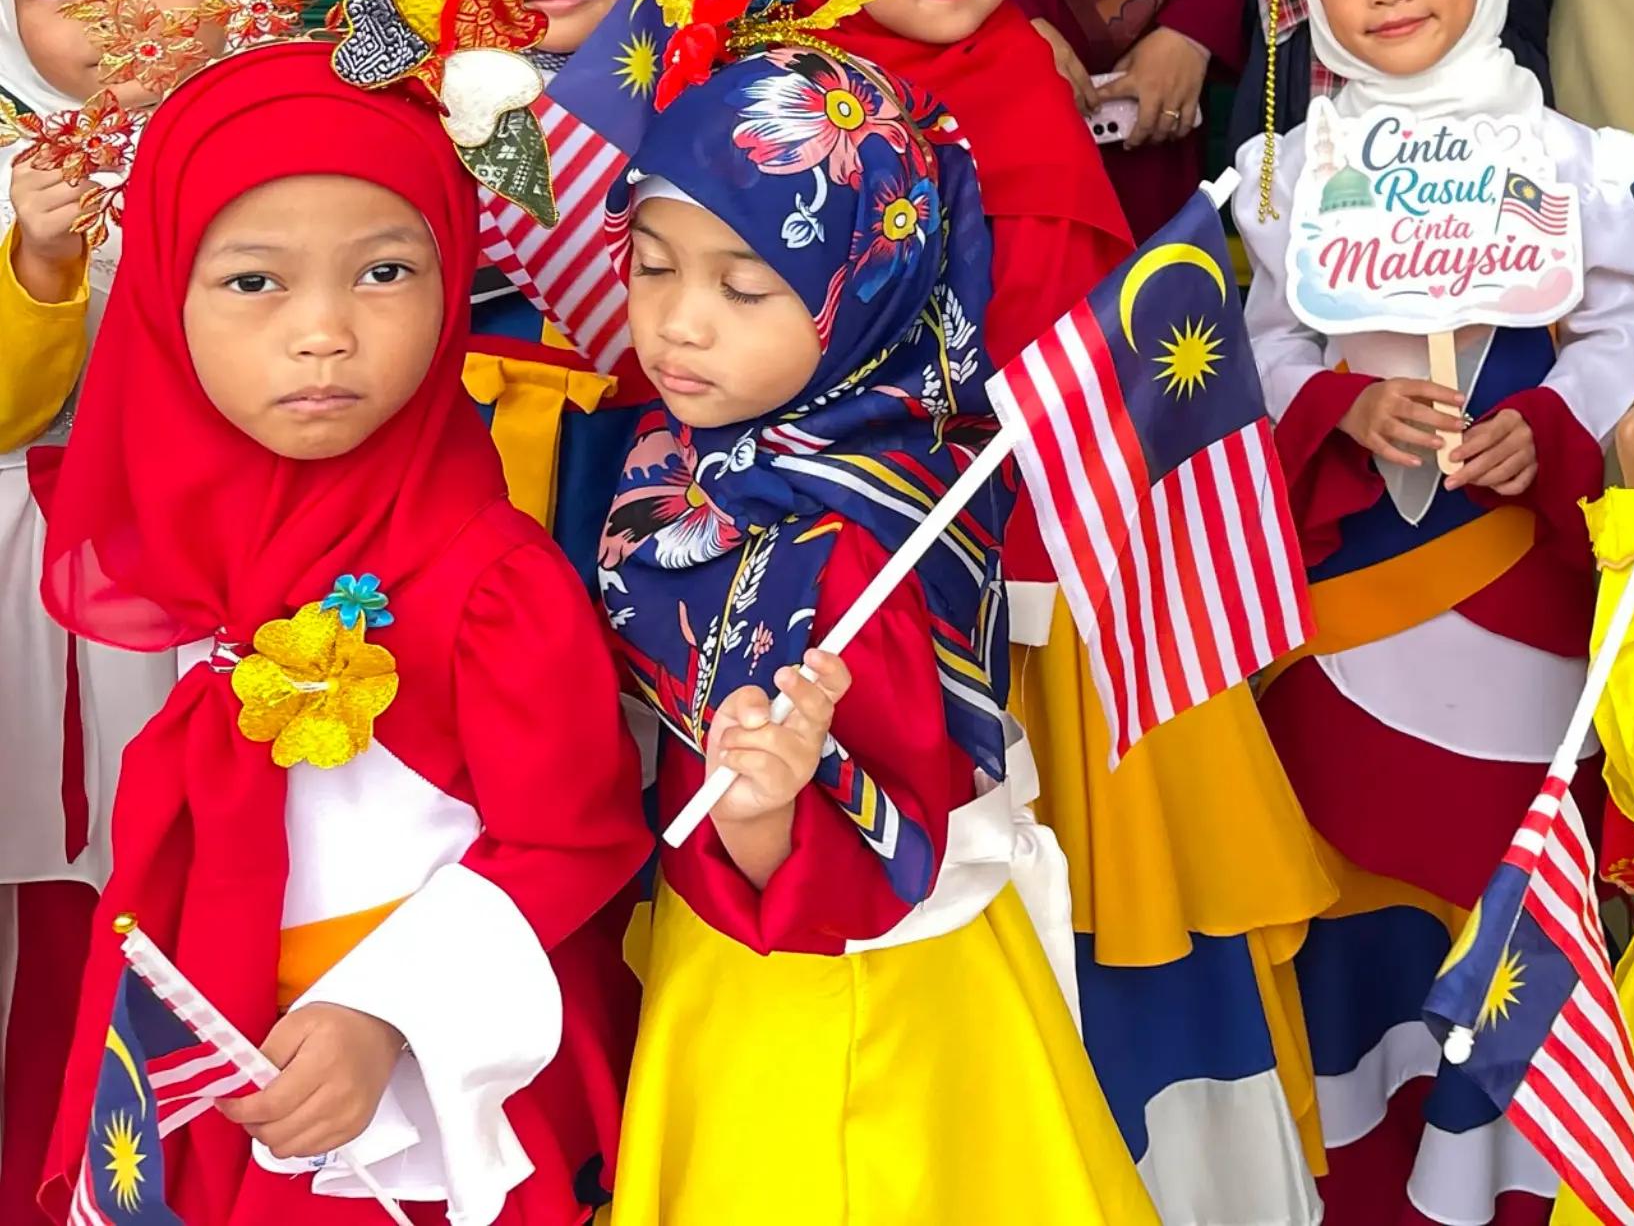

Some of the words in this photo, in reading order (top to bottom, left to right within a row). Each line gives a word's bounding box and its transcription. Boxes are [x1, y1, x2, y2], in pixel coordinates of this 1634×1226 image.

[1361, 117, 1473, 171] Cinta
[1374, 165, 1496, 216] Rasul,
[1391, 213, 1473, 244] Cinta
[1318, 235, 1546, 298] Malaysia
